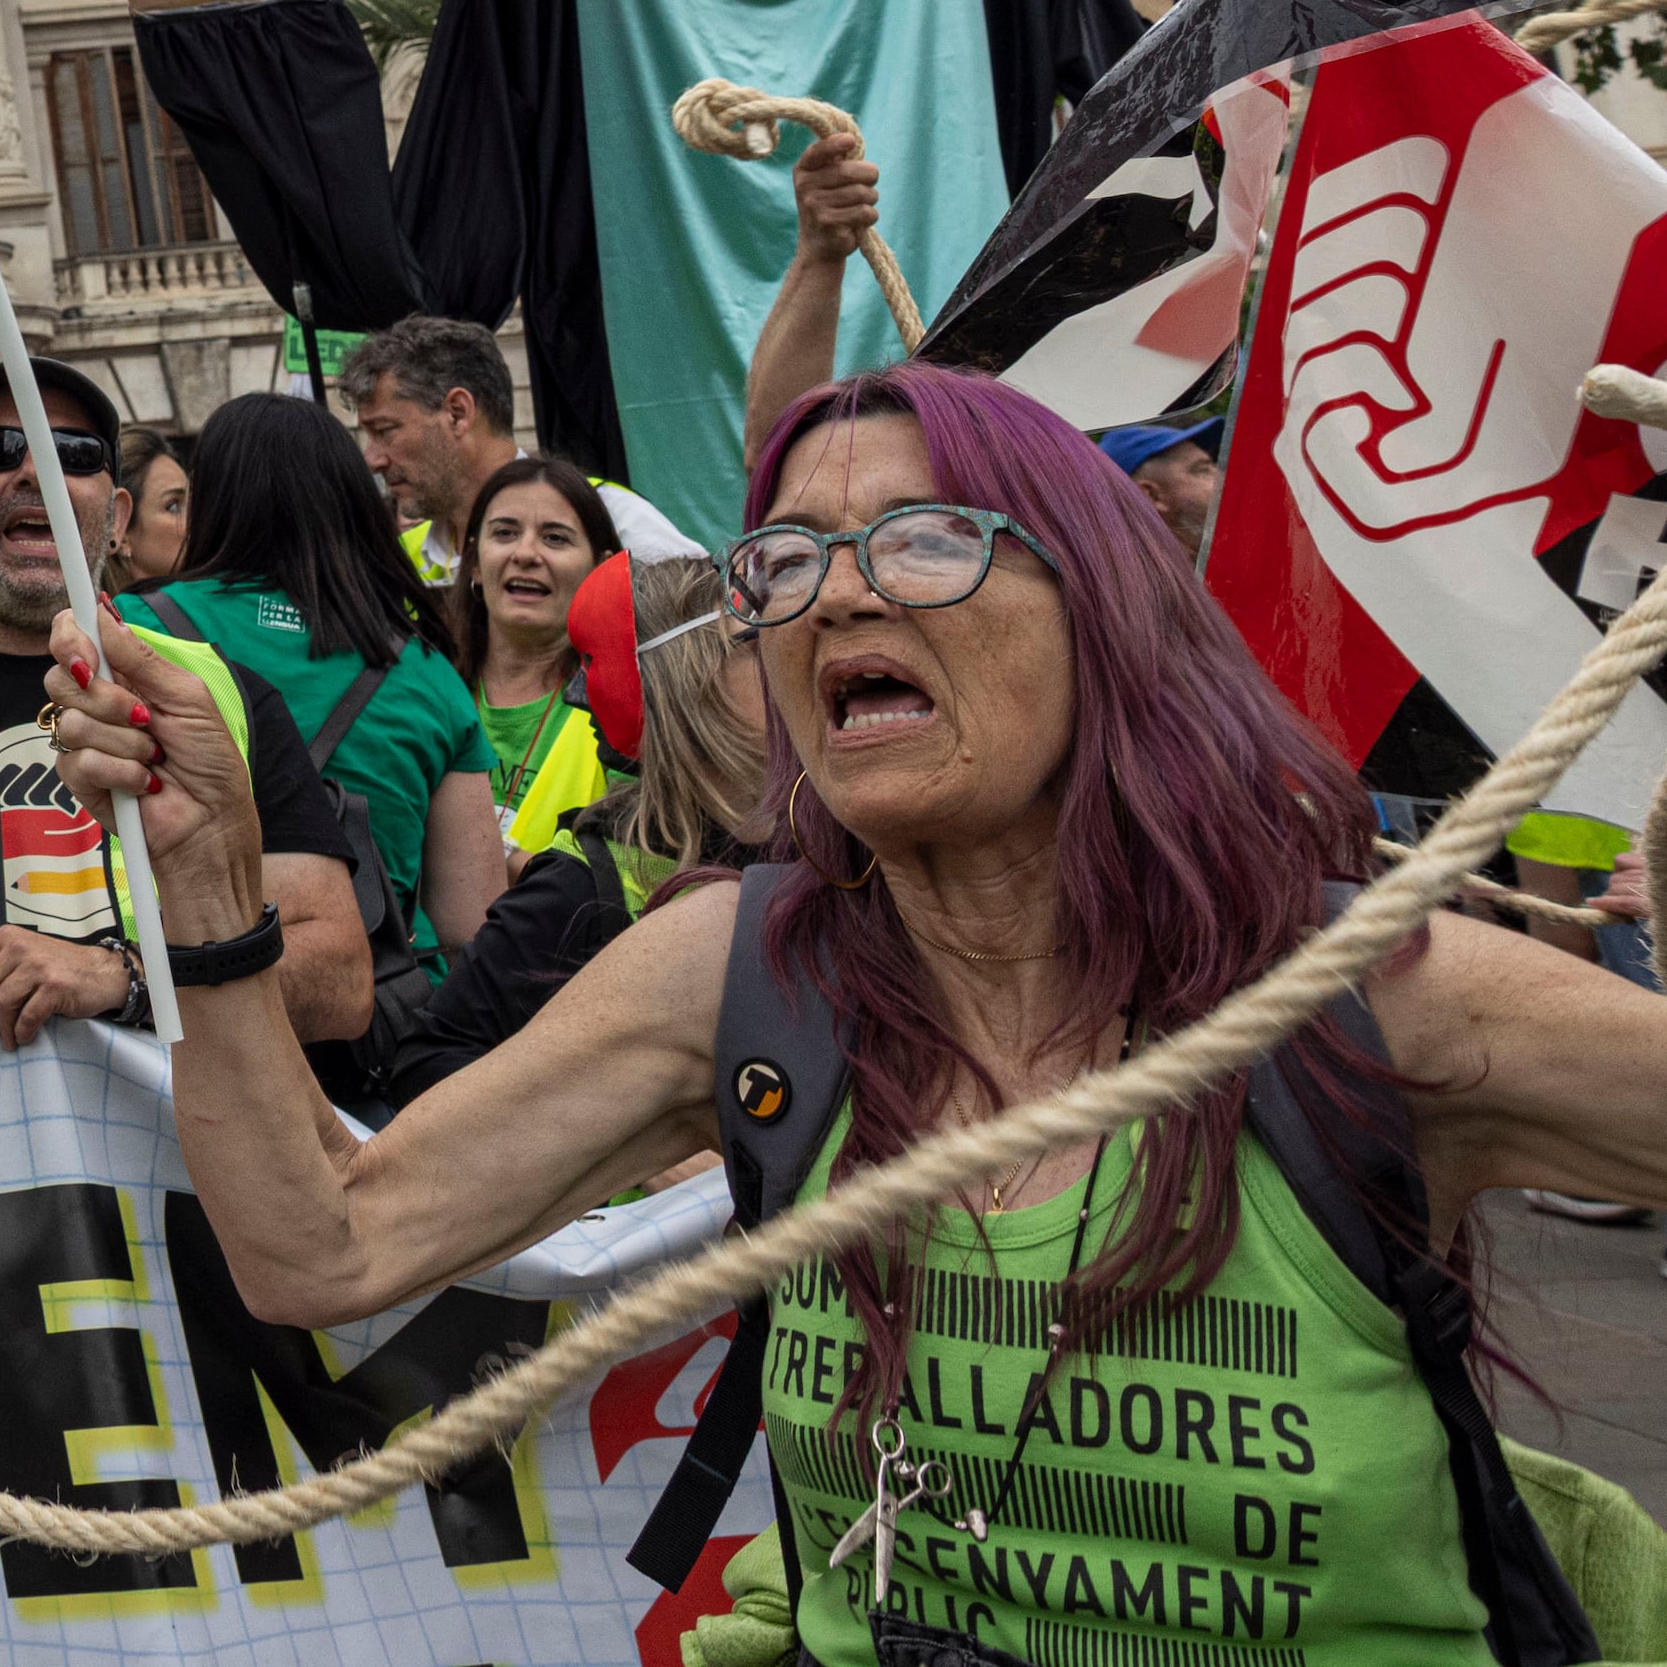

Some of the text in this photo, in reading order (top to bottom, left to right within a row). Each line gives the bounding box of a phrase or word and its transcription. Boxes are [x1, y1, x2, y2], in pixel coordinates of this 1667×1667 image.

[262, 611, 301, 623] PER LA
[1233, 1494, 1323, 1566] DE
